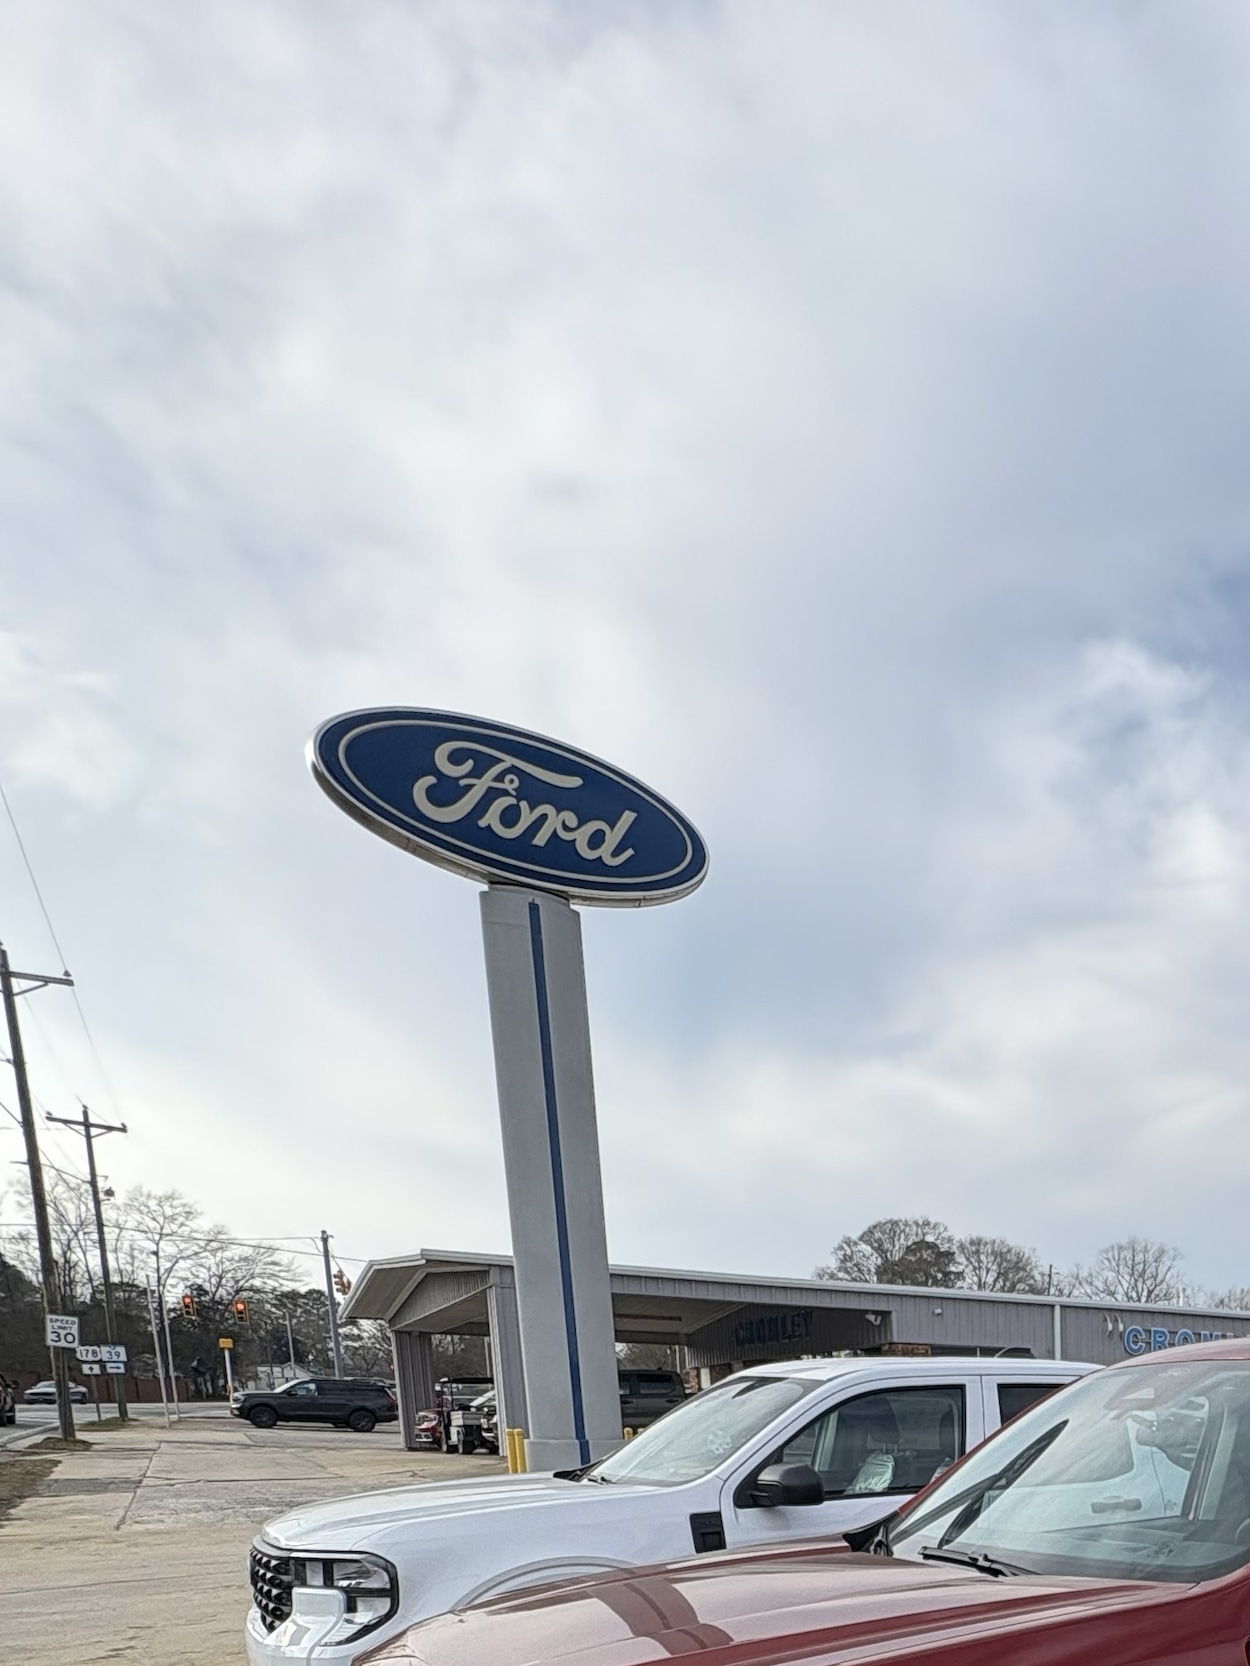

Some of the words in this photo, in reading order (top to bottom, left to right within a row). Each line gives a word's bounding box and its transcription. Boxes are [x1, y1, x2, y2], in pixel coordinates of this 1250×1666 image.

[413, 740, 637, 867] Ford
[50, 1331, 76, 1344] 30
[79, 1349, 98, 1358] 178
[106, 1351, 121, 1360] 39
